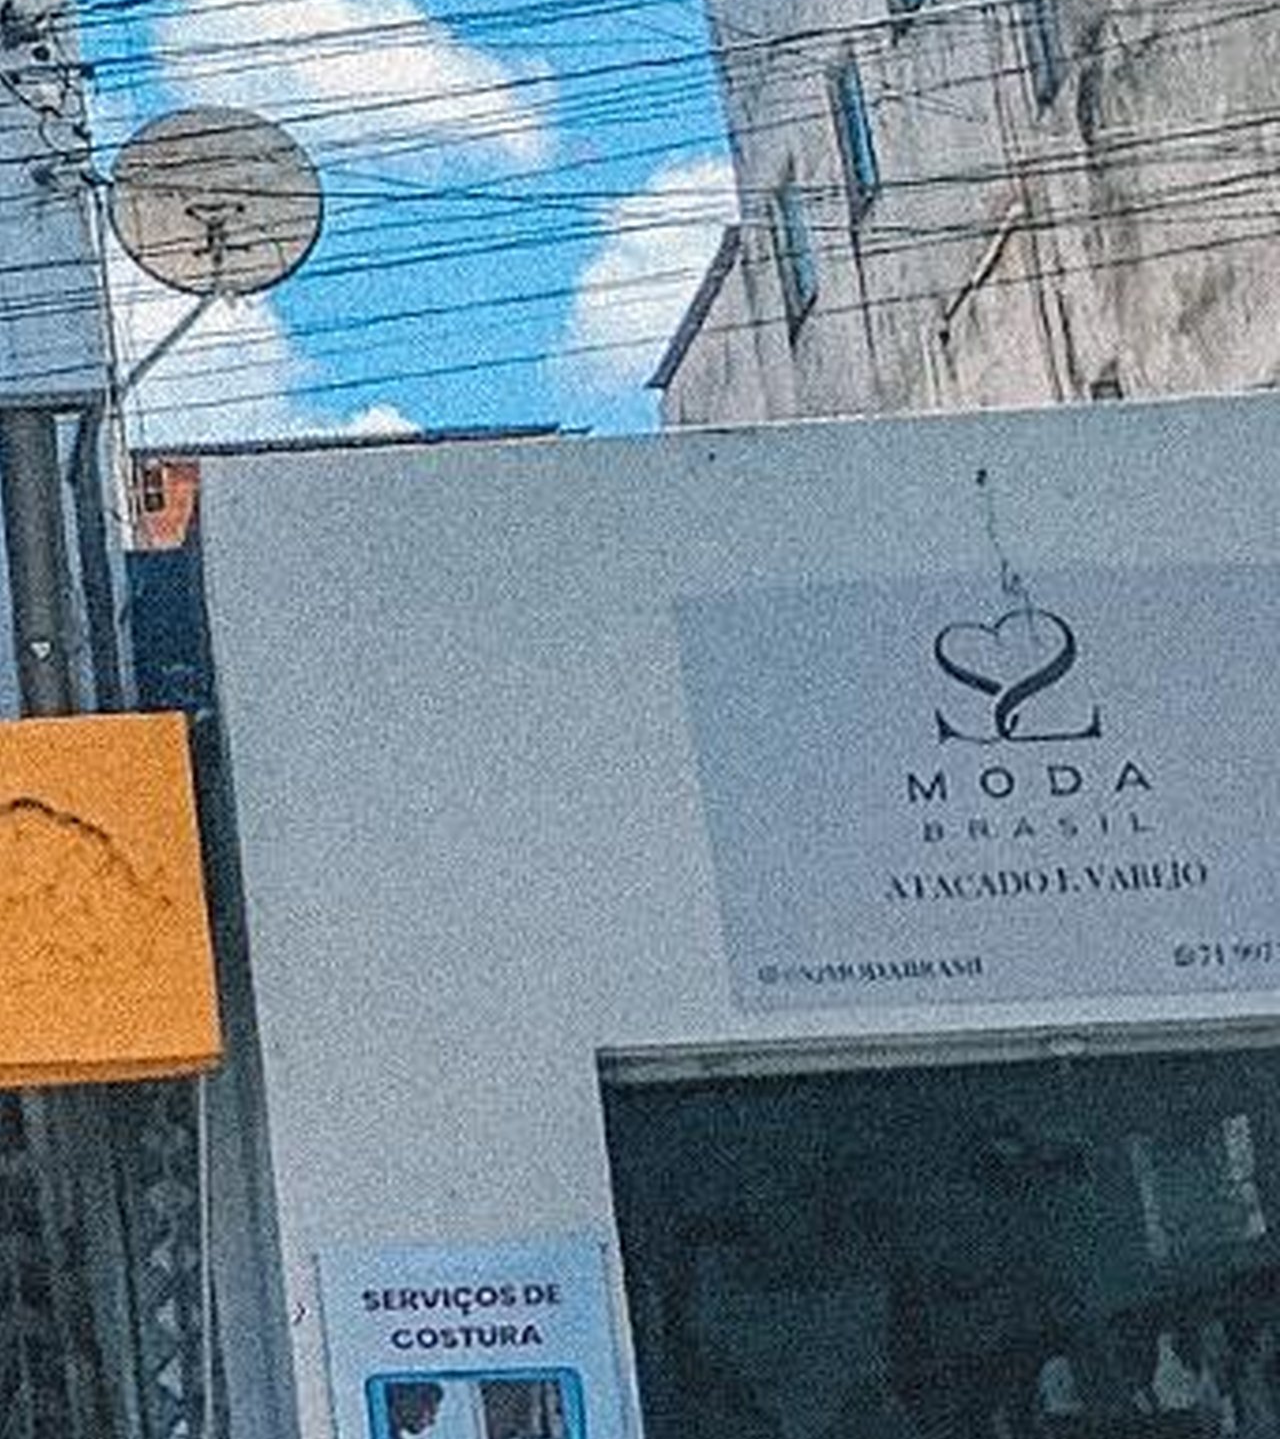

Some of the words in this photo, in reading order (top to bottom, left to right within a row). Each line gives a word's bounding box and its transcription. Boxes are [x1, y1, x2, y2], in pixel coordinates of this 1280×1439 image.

[906, 760, 1152, 803] MODA
[924, 811, 1156, 843] BRASIL
[885, 870, 1049, 900] ATACADO
[1056, 867, 1081, 894] E
[1084, 860, 1208, 893] VAREJO
[362, 1284, 518, 1315] SERVIÇOS
[524, 1283, 562, 1306] DE
[391, 1324, 544, 1350] COSTURA
